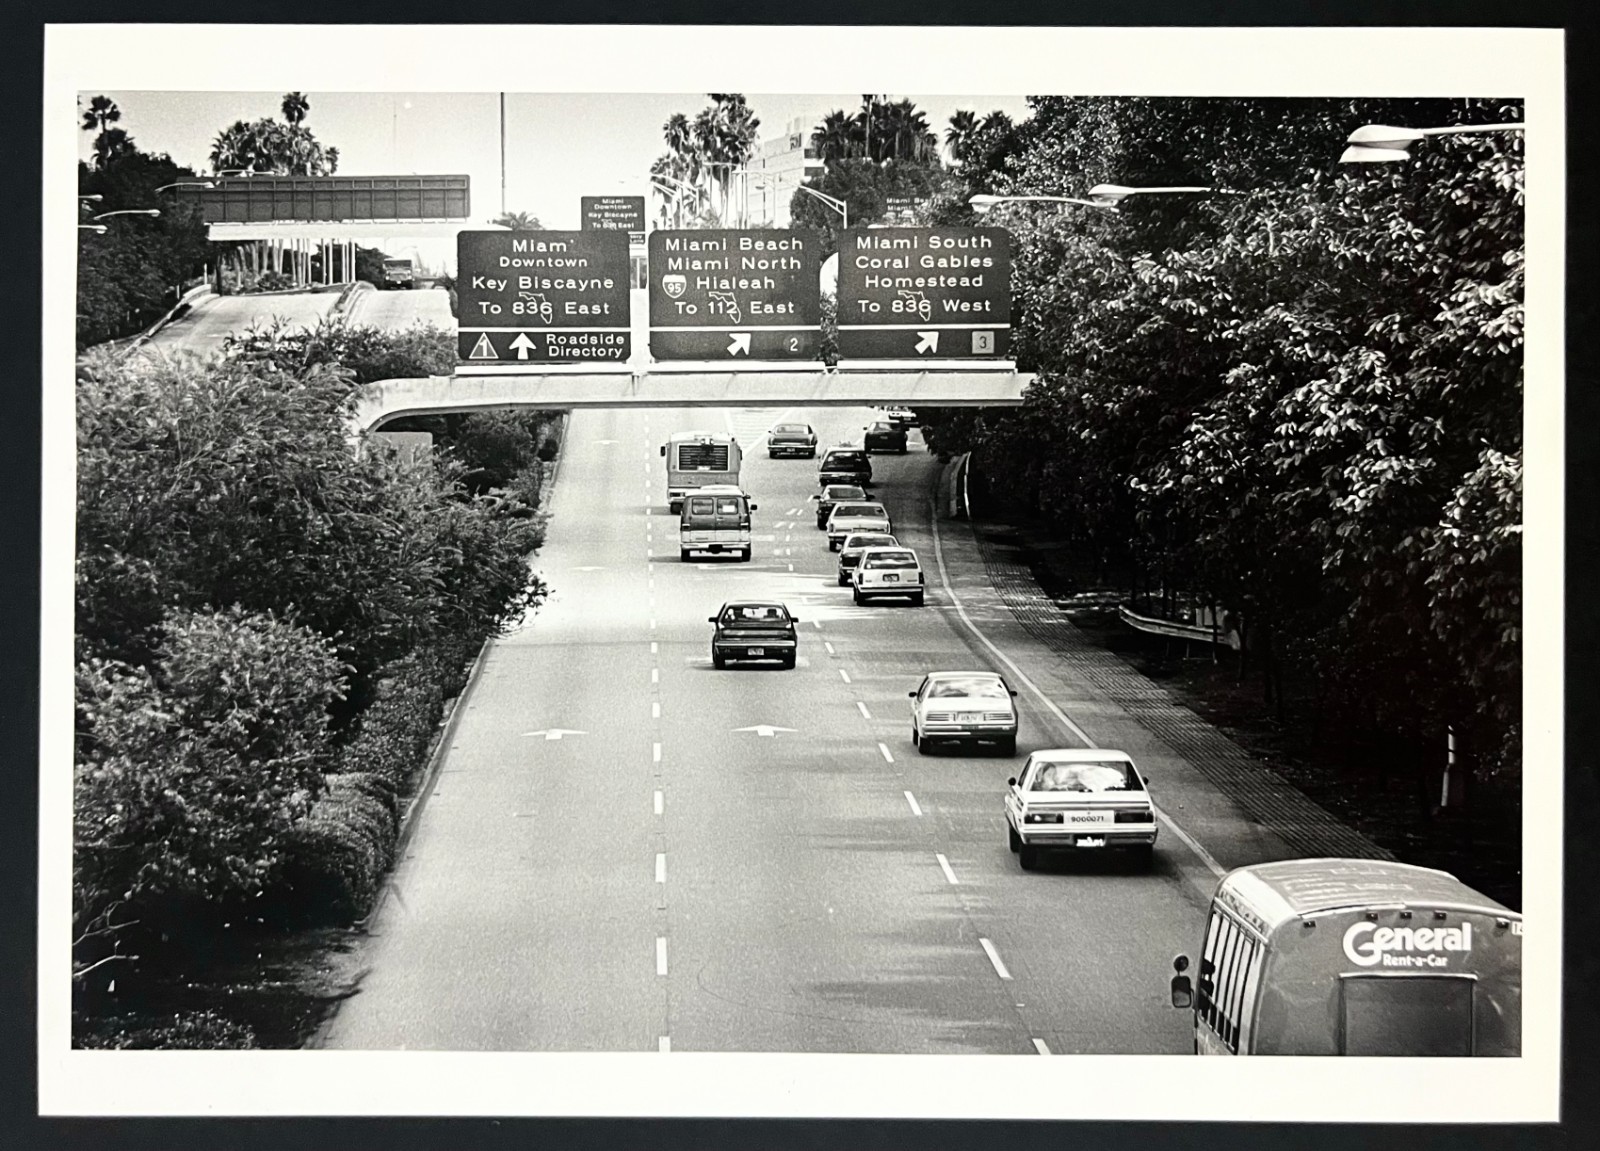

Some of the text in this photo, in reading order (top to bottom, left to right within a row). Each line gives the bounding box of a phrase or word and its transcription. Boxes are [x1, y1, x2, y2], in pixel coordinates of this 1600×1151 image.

[512, 239, 574, 252] Miam
[666, 237, 803, 251] Miami Beach
[856, 235, 992, 249] Miami South
[499, 256, 588, 267] Downtown
[668, 256, 802, 271] Miami North
[855, 255, 993, 269] Coral Gables
[472, 276, 614, 291] Key Biscayne
[667, 283, 682, 293] 95
[696, 276, 775, 290] Hialeah
[865, 274, 983, 288] Homestead
[478, 301, 610, 315] To 836 East
[674, 301, 794, 315] To 112 East
[858, 299, 991, 313] To 836 West
[546, 334, 625, 345] Roadside
[790, 338, 798, 351] 2
[979, 336, 987, 349] 3
[479, 340, 488, 357] 1
[548, 345, 623, 359] Directory
[1342, 921, 1472, 967] General
[1383, 953, 1448, 967] Rent-a-Car
